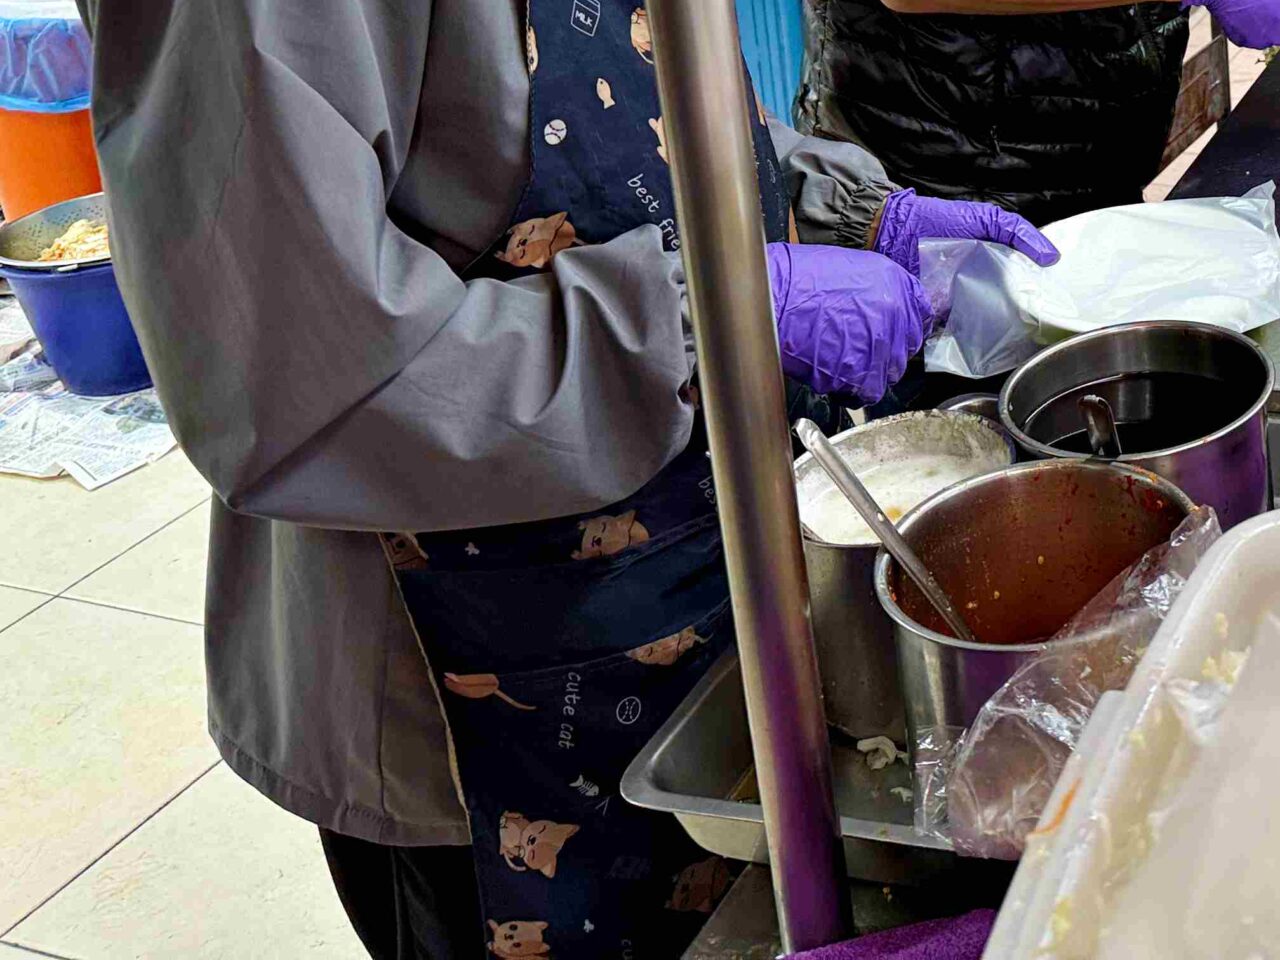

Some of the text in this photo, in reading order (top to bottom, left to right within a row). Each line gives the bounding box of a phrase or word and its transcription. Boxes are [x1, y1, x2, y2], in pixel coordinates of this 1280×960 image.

[627, 173, 660, 213] best
[558, 671, 583, 751] cute cat
